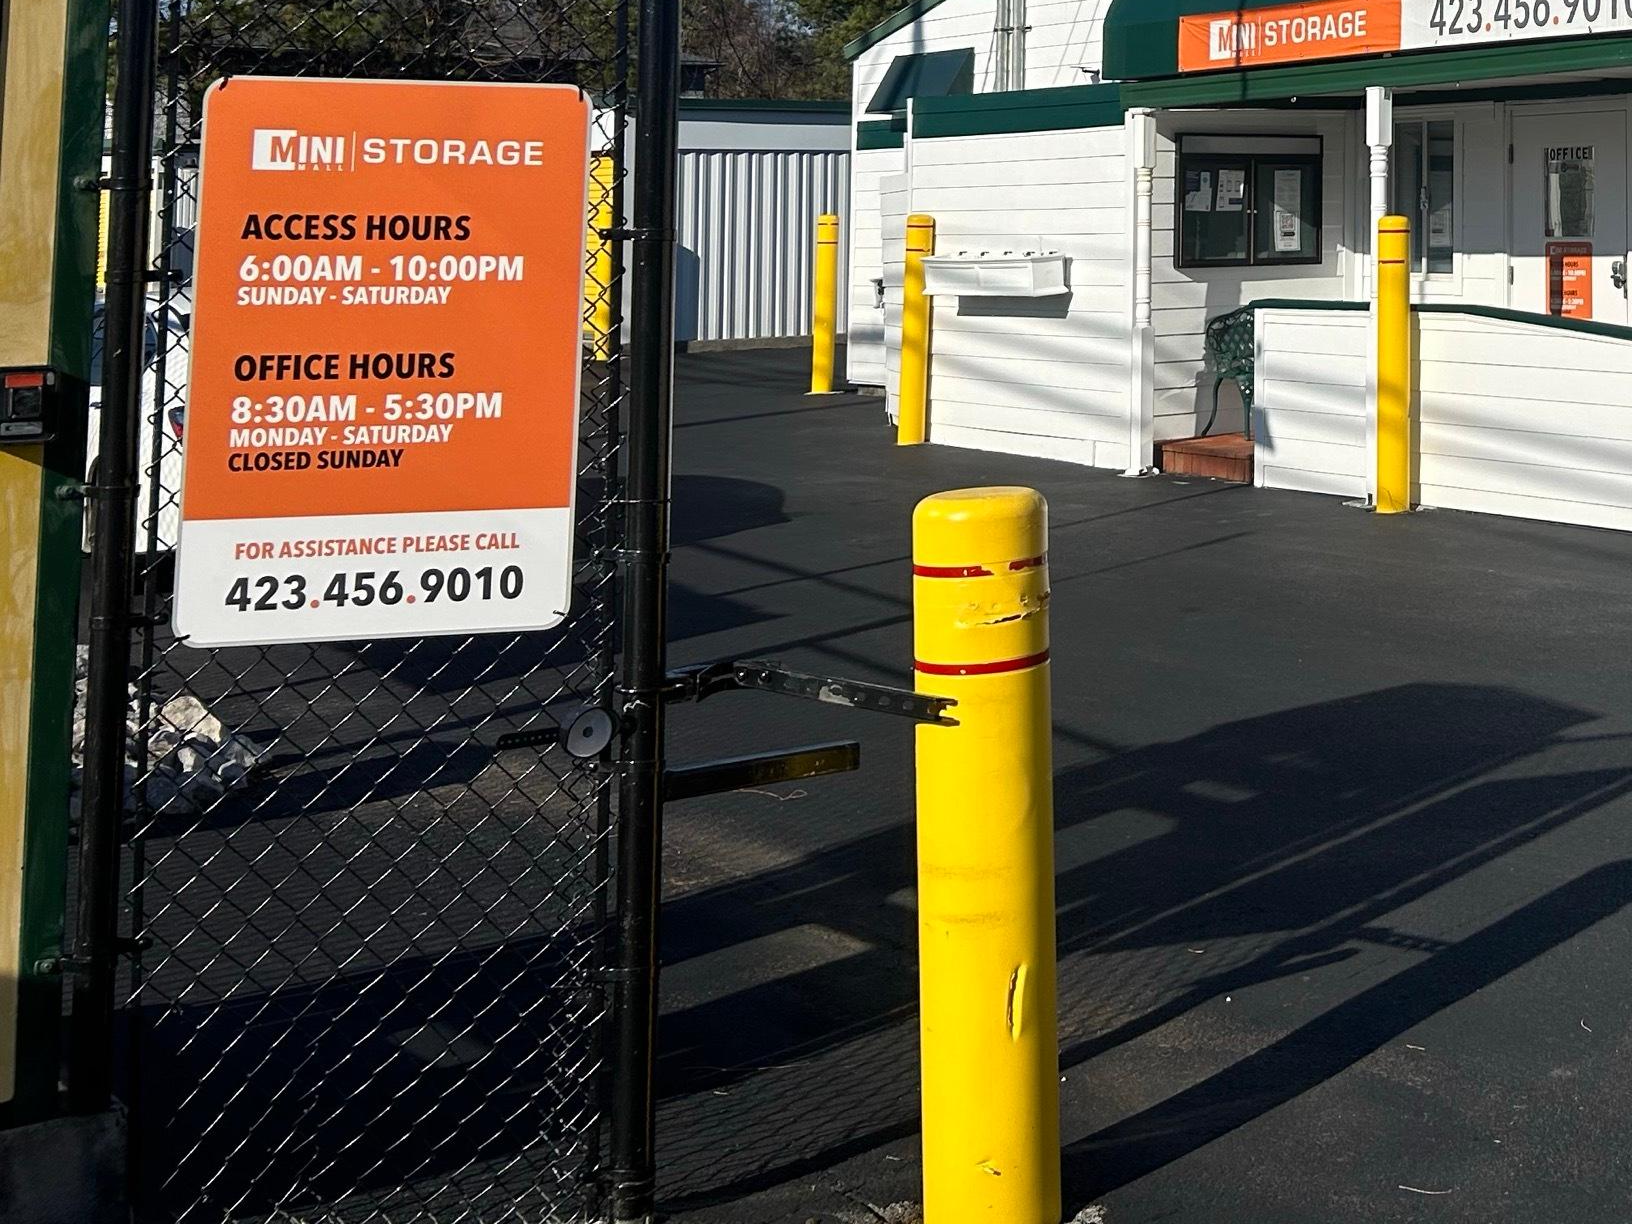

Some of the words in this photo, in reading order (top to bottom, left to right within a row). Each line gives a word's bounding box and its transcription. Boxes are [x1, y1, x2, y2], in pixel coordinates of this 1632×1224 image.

[1215, 20, 1257, 54] MINI
[1264, 9, 1368, 47] STORAGE
[266, 134, 346, 165] MINI
[362, 137, 545, 167] STORAGE
[1549, 146, 1589, 161] OFFICE
[240, 213, 358, 241] ACCESS
[365, 214, 472, 242] HOURS
[239, 254, 363, 282] 6:00AM
[389, 254, 525, 282] 10:00PM
[237, 286, 328, 306] SUNDAY
[341, 286, 452, 306] SATURDAY
[234, 353, 340, 382] OFFICE
[348, 351, 456, 380] HOURS
[231, 393, 358, 424] 8:30AM
[383, 391, 504, 421] 5:30PM
[229, 426, 329, 448] MONDAY
[342, 423, 454, 446] SATURDAY
[227, 450, 312, 473] CLOSED
[316, 448, 405, 470] SUNDAY
[234, 541, 275, 561] FOR
[278, 536, 398, 559] ASSISTANCE
[401, 533, 471, 554] PLEASE
[474, 532, 521, 551] CALL
[224, 564, 525, 613] 423.456.9010
